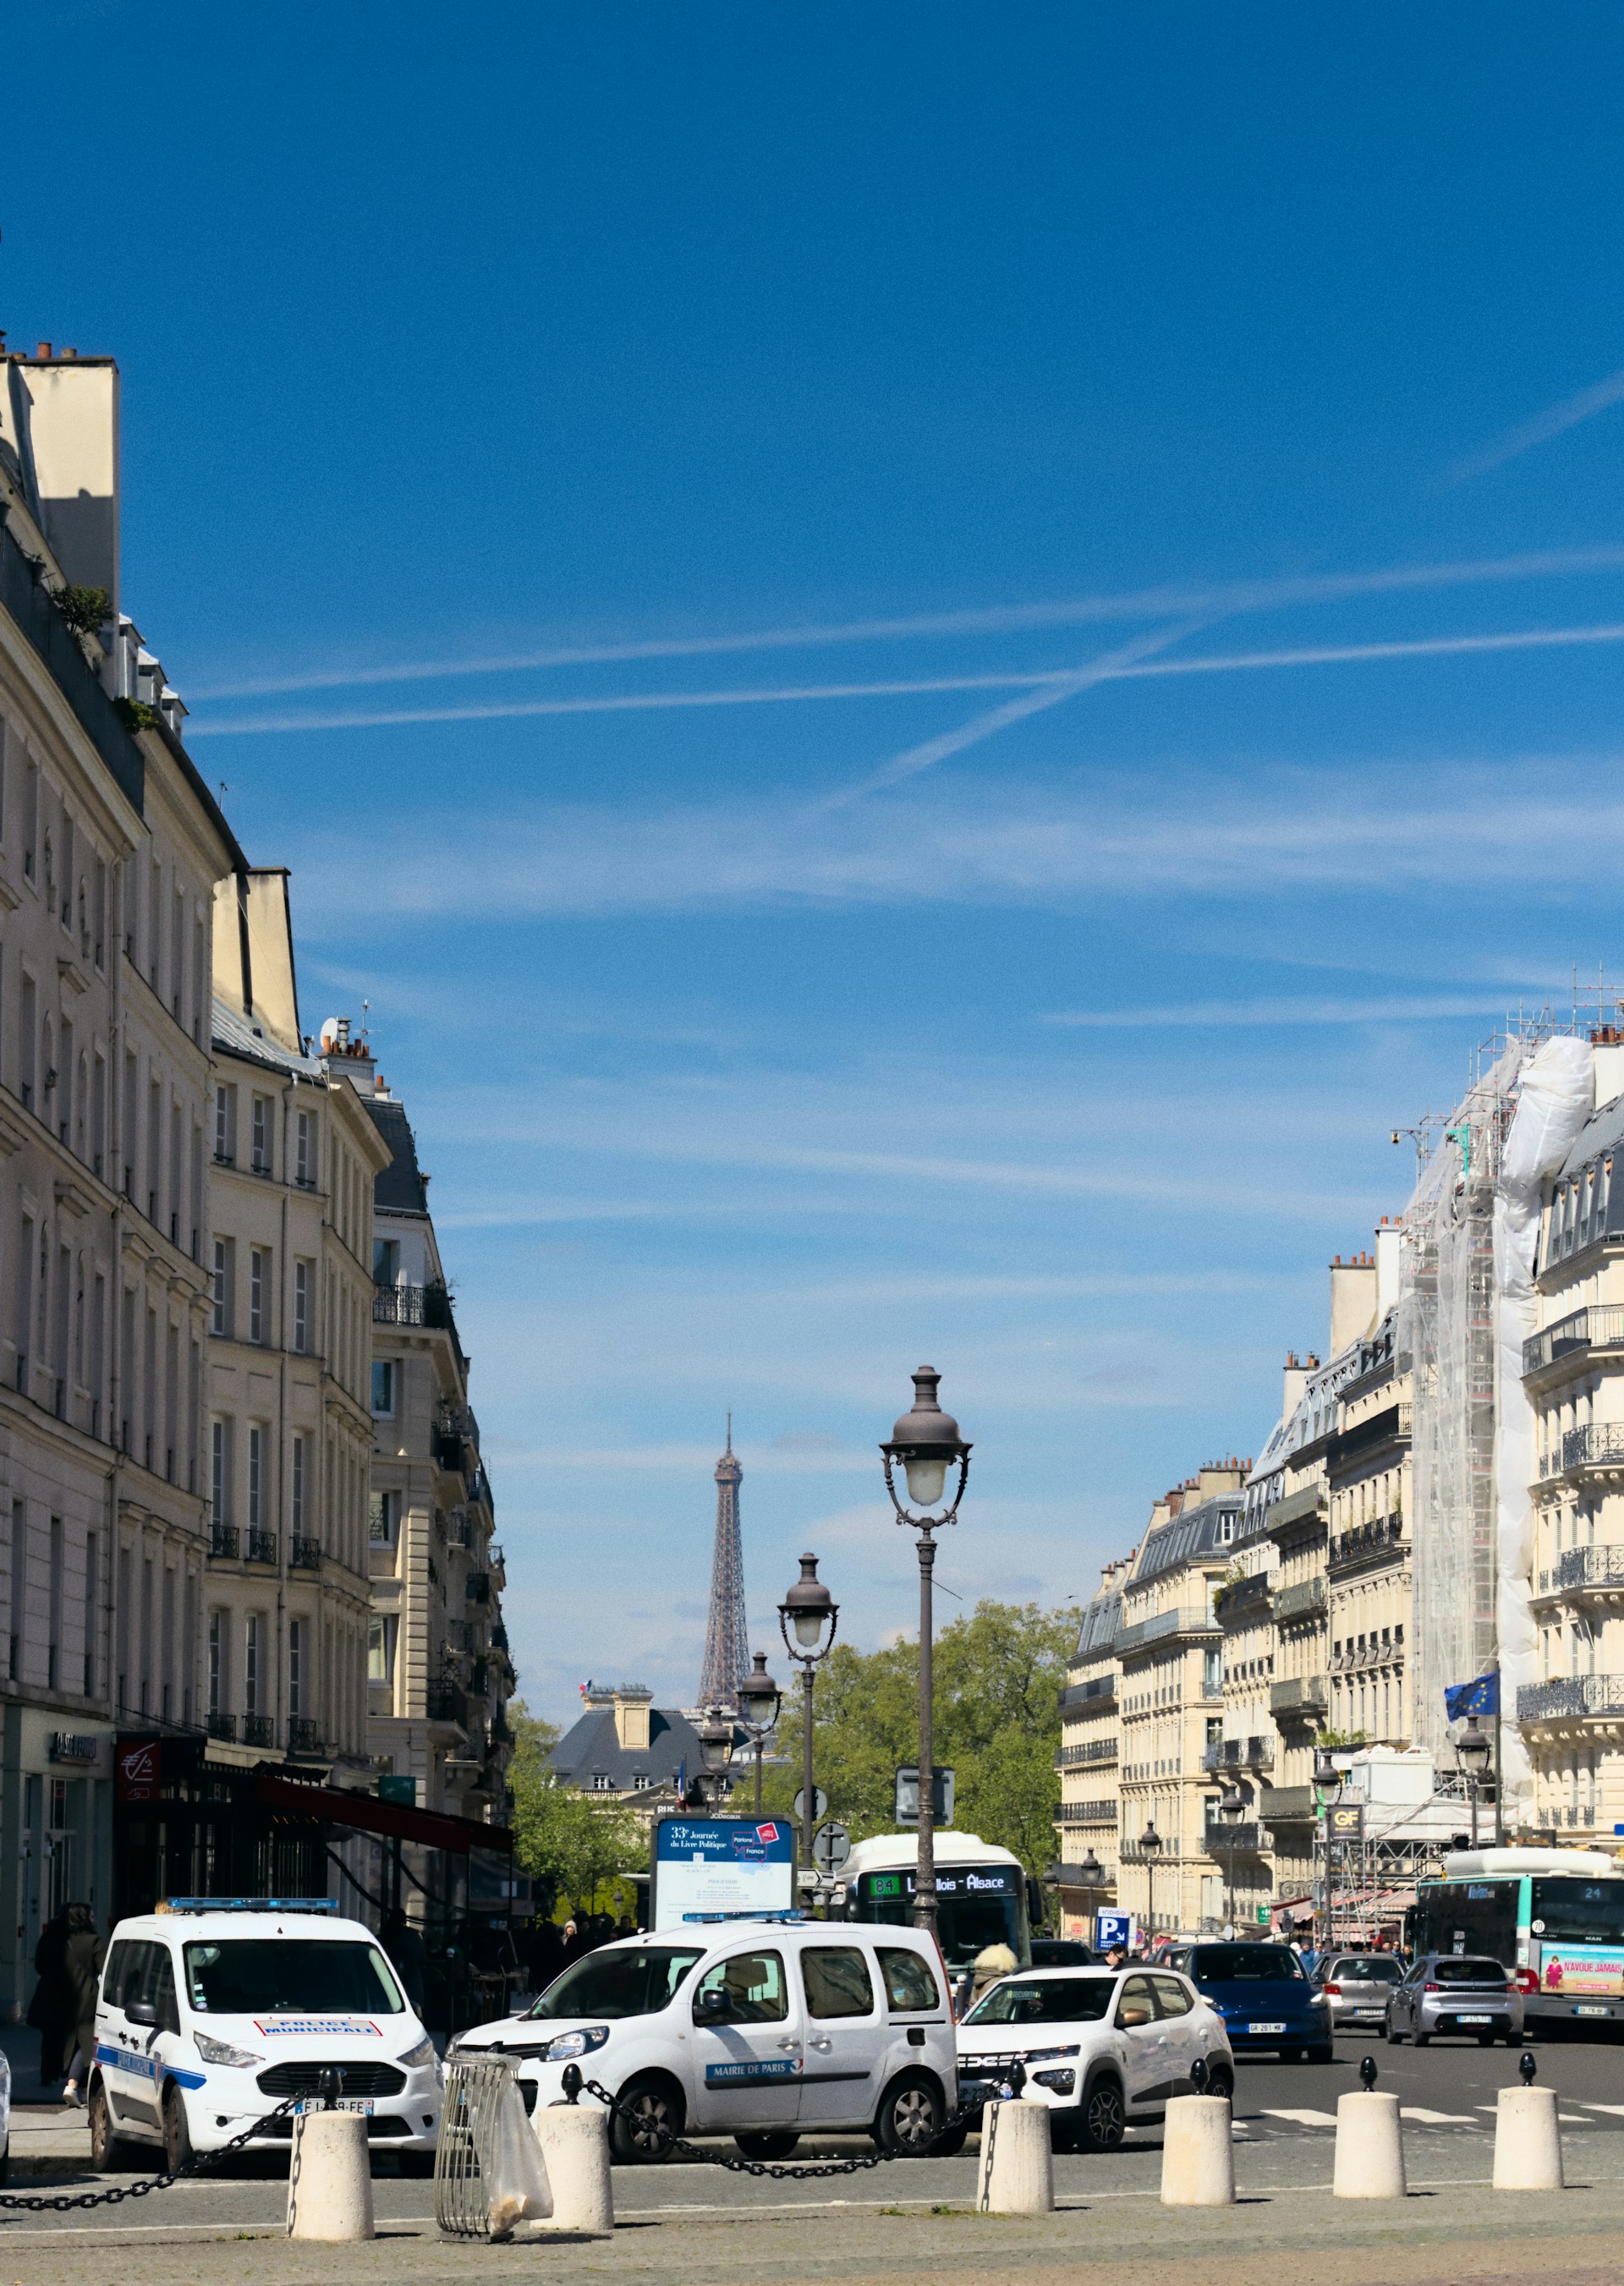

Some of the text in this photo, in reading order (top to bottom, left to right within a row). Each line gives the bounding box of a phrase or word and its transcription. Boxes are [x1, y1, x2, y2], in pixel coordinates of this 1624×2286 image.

[690, 1830, 719, 1840] Journée
[670, 1839, 727, 1850] du Livre Politique
[875, 1879, 894, 1894] 84
[907, 1877, 956, 1894] Lllois
[967, 1873, 1004, 1890] Alsace
[1585, 1887, 1601, 1899] 24
[1100, 1917, 1119, 1940] P
[1535, 1921, 1543, 1932] 70
[1564, 1962, 1623, 1974] N'AVOUE JAMAIS
[714, 2063, 786, 2076] MAIRIE DE PARIS
